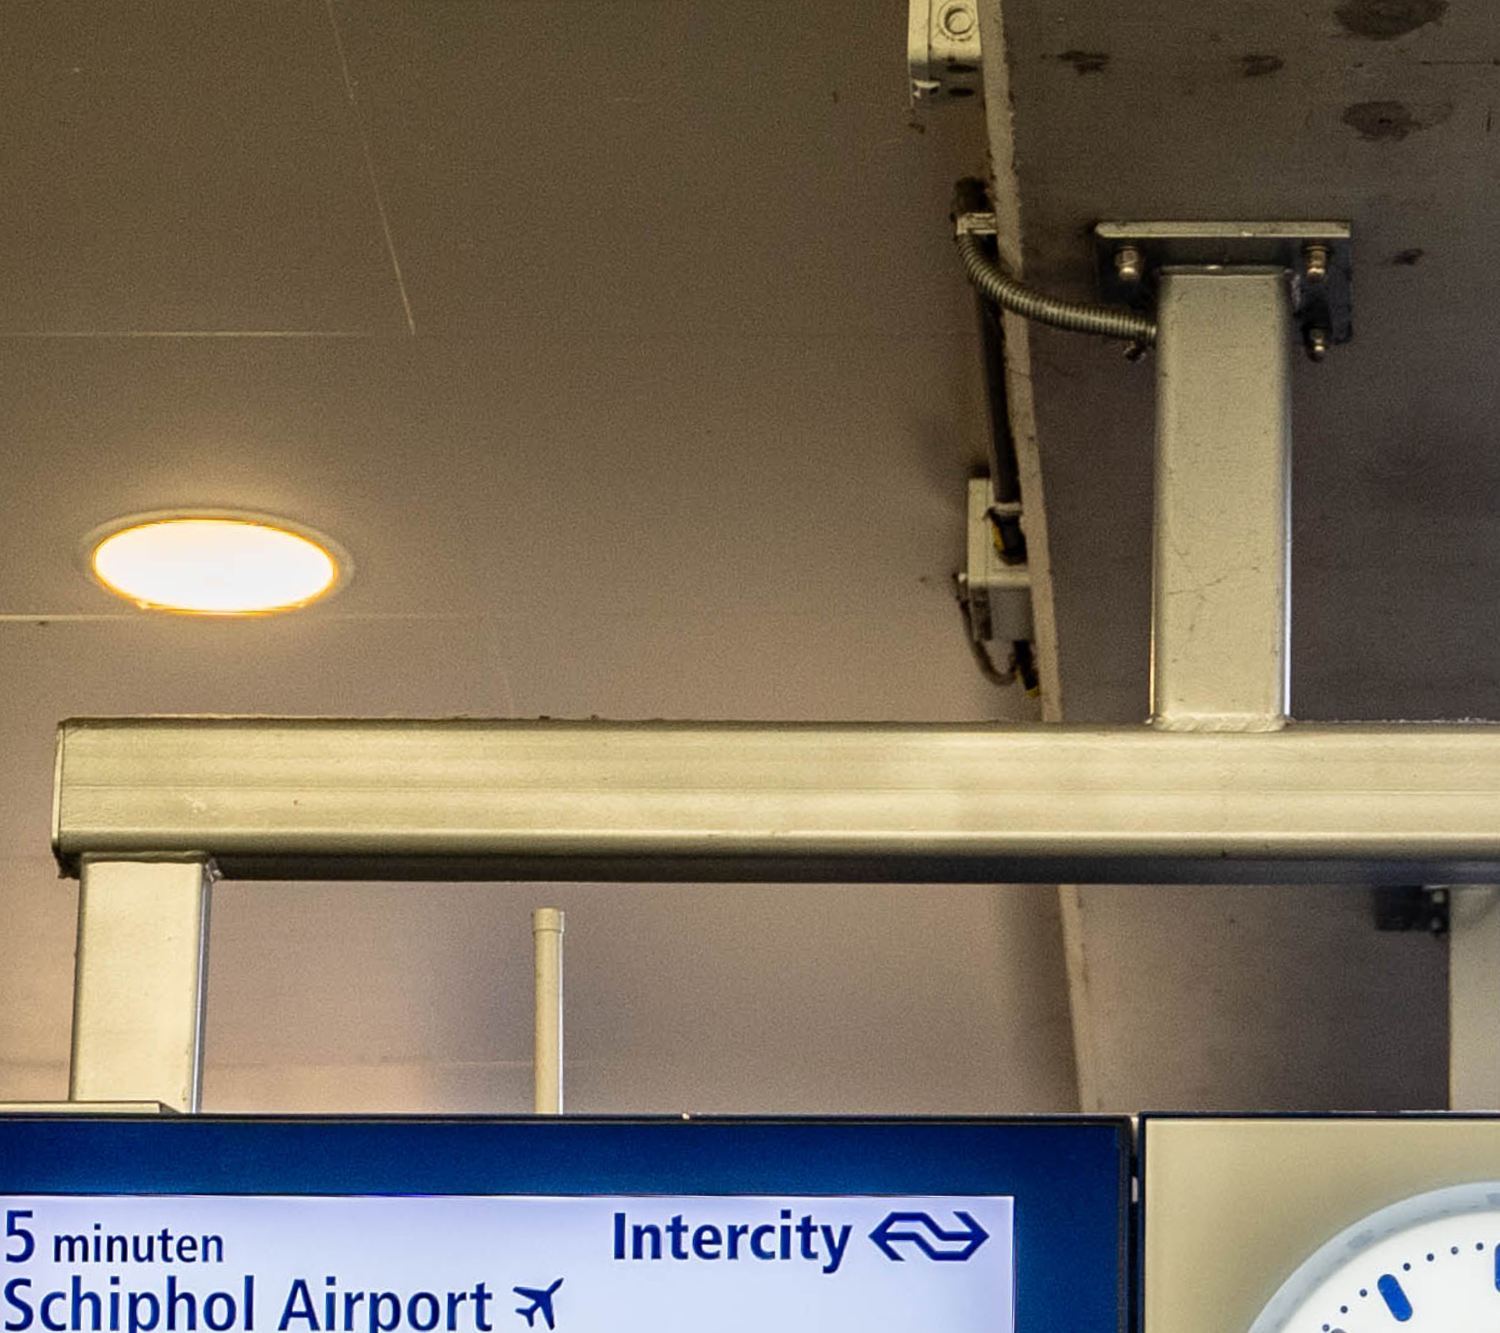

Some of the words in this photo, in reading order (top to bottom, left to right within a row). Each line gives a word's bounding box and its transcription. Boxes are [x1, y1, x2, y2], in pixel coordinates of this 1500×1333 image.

[5, 1210, 36, 1263] 5
[54, 1224, 224, 1263] minuten
[613, 1209, 853, 1274] Intercity
